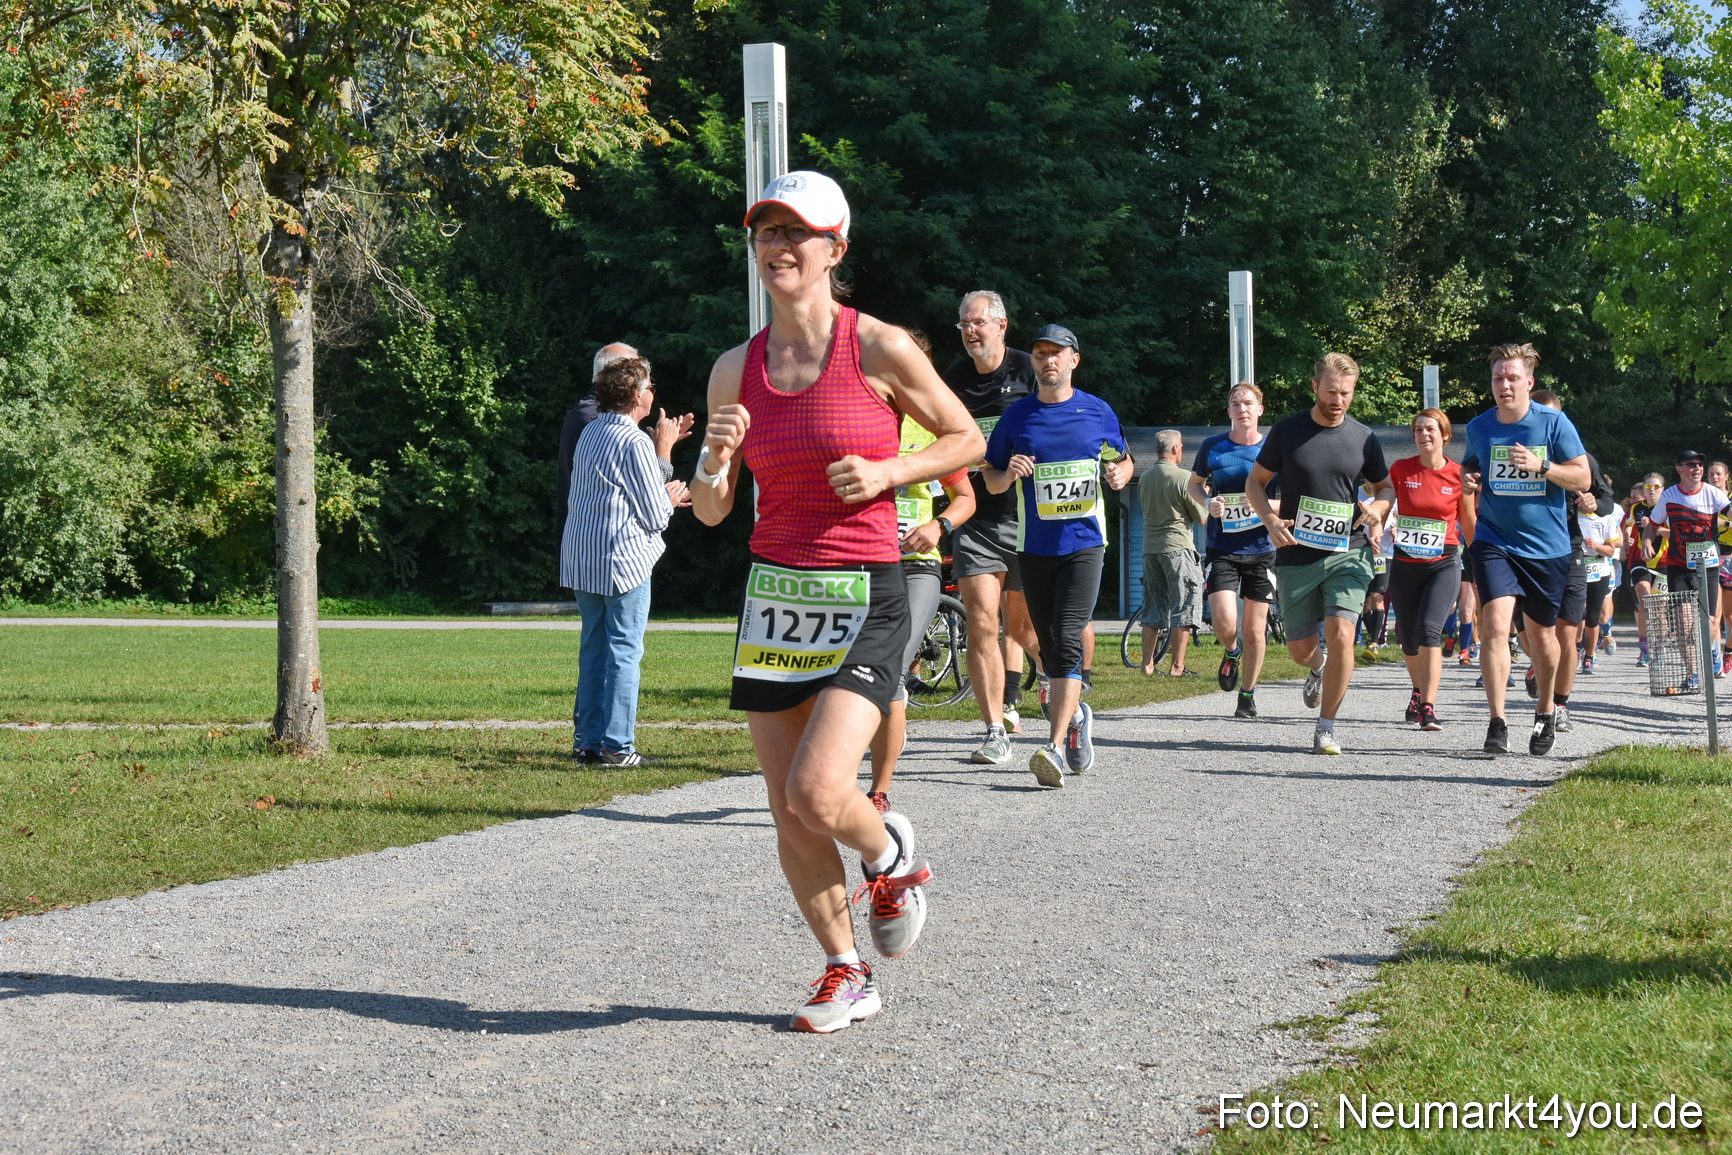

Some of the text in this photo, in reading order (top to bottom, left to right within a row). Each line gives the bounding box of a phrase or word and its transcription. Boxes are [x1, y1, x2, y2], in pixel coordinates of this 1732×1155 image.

[1040, 464, 1088, 477] BOCK
[1043, 480, 1089, 500] 1247
[1494, 482, 1540, 490] CHRISTIAN
[1056, 504, 1082, 513] RYAN
[1225, 506, 1253, 520] 210
[1304, 499, 1347, 515] BOCK
[1235, 519, 1254, 528] PAUL
[1301, 514, 1346, 535] 2280
[1402, 518, 1441, 531] BOCK
[1298, 532, 1344, 546] ALEXANDER
[1401, 530, 1439, 546] 2167
[756, 571, 856, 601] BOCK
[760, 606, 853, 645] 1275
[753, 651, 836, 669] JENNIFER
